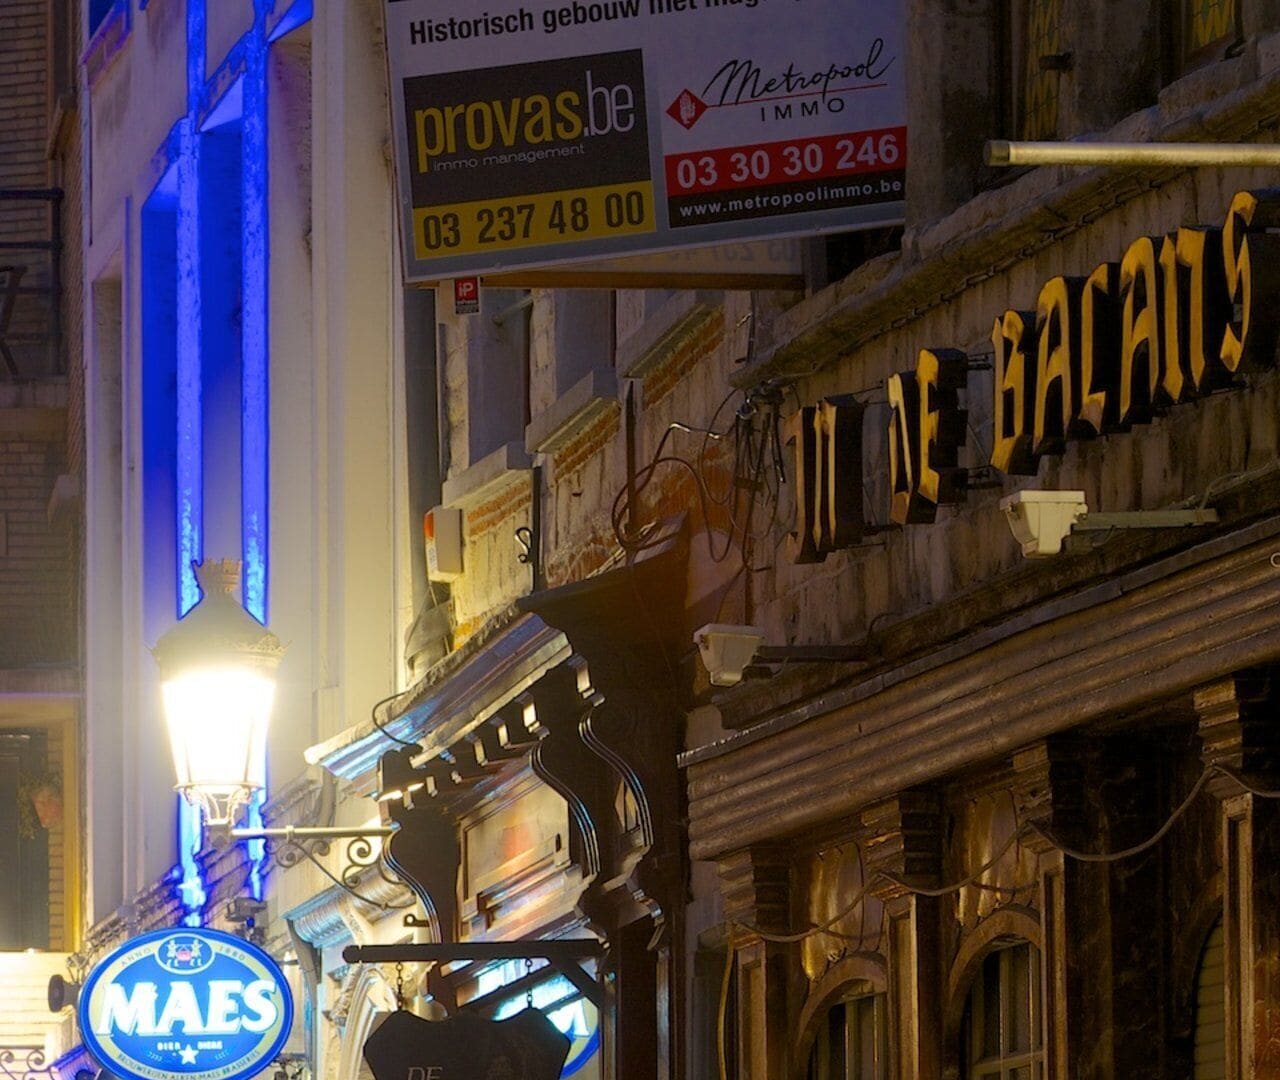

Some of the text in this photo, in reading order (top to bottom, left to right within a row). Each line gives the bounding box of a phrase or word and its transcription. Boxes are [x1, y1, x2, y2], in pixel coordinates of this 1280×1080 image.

[410, 8, 534, 45] Historisch
[542, 0, 641, 34] gebouw
[702, 38, 896, 108] Metropool
[414, 70, 635, 174] provas.be
[761, 98, 845, 122] IMMO
[433, 143, 585, 172] immo management
[676, 133, 900, 189] 03 30 30 246
[423, 190, 645, 250] 03 237 48 00
[679, 179, 902, 218] www.metropoolimmo.be
[990, 190, 1257, 476] BALANS
[95, 979, 278, 1038] MAES
